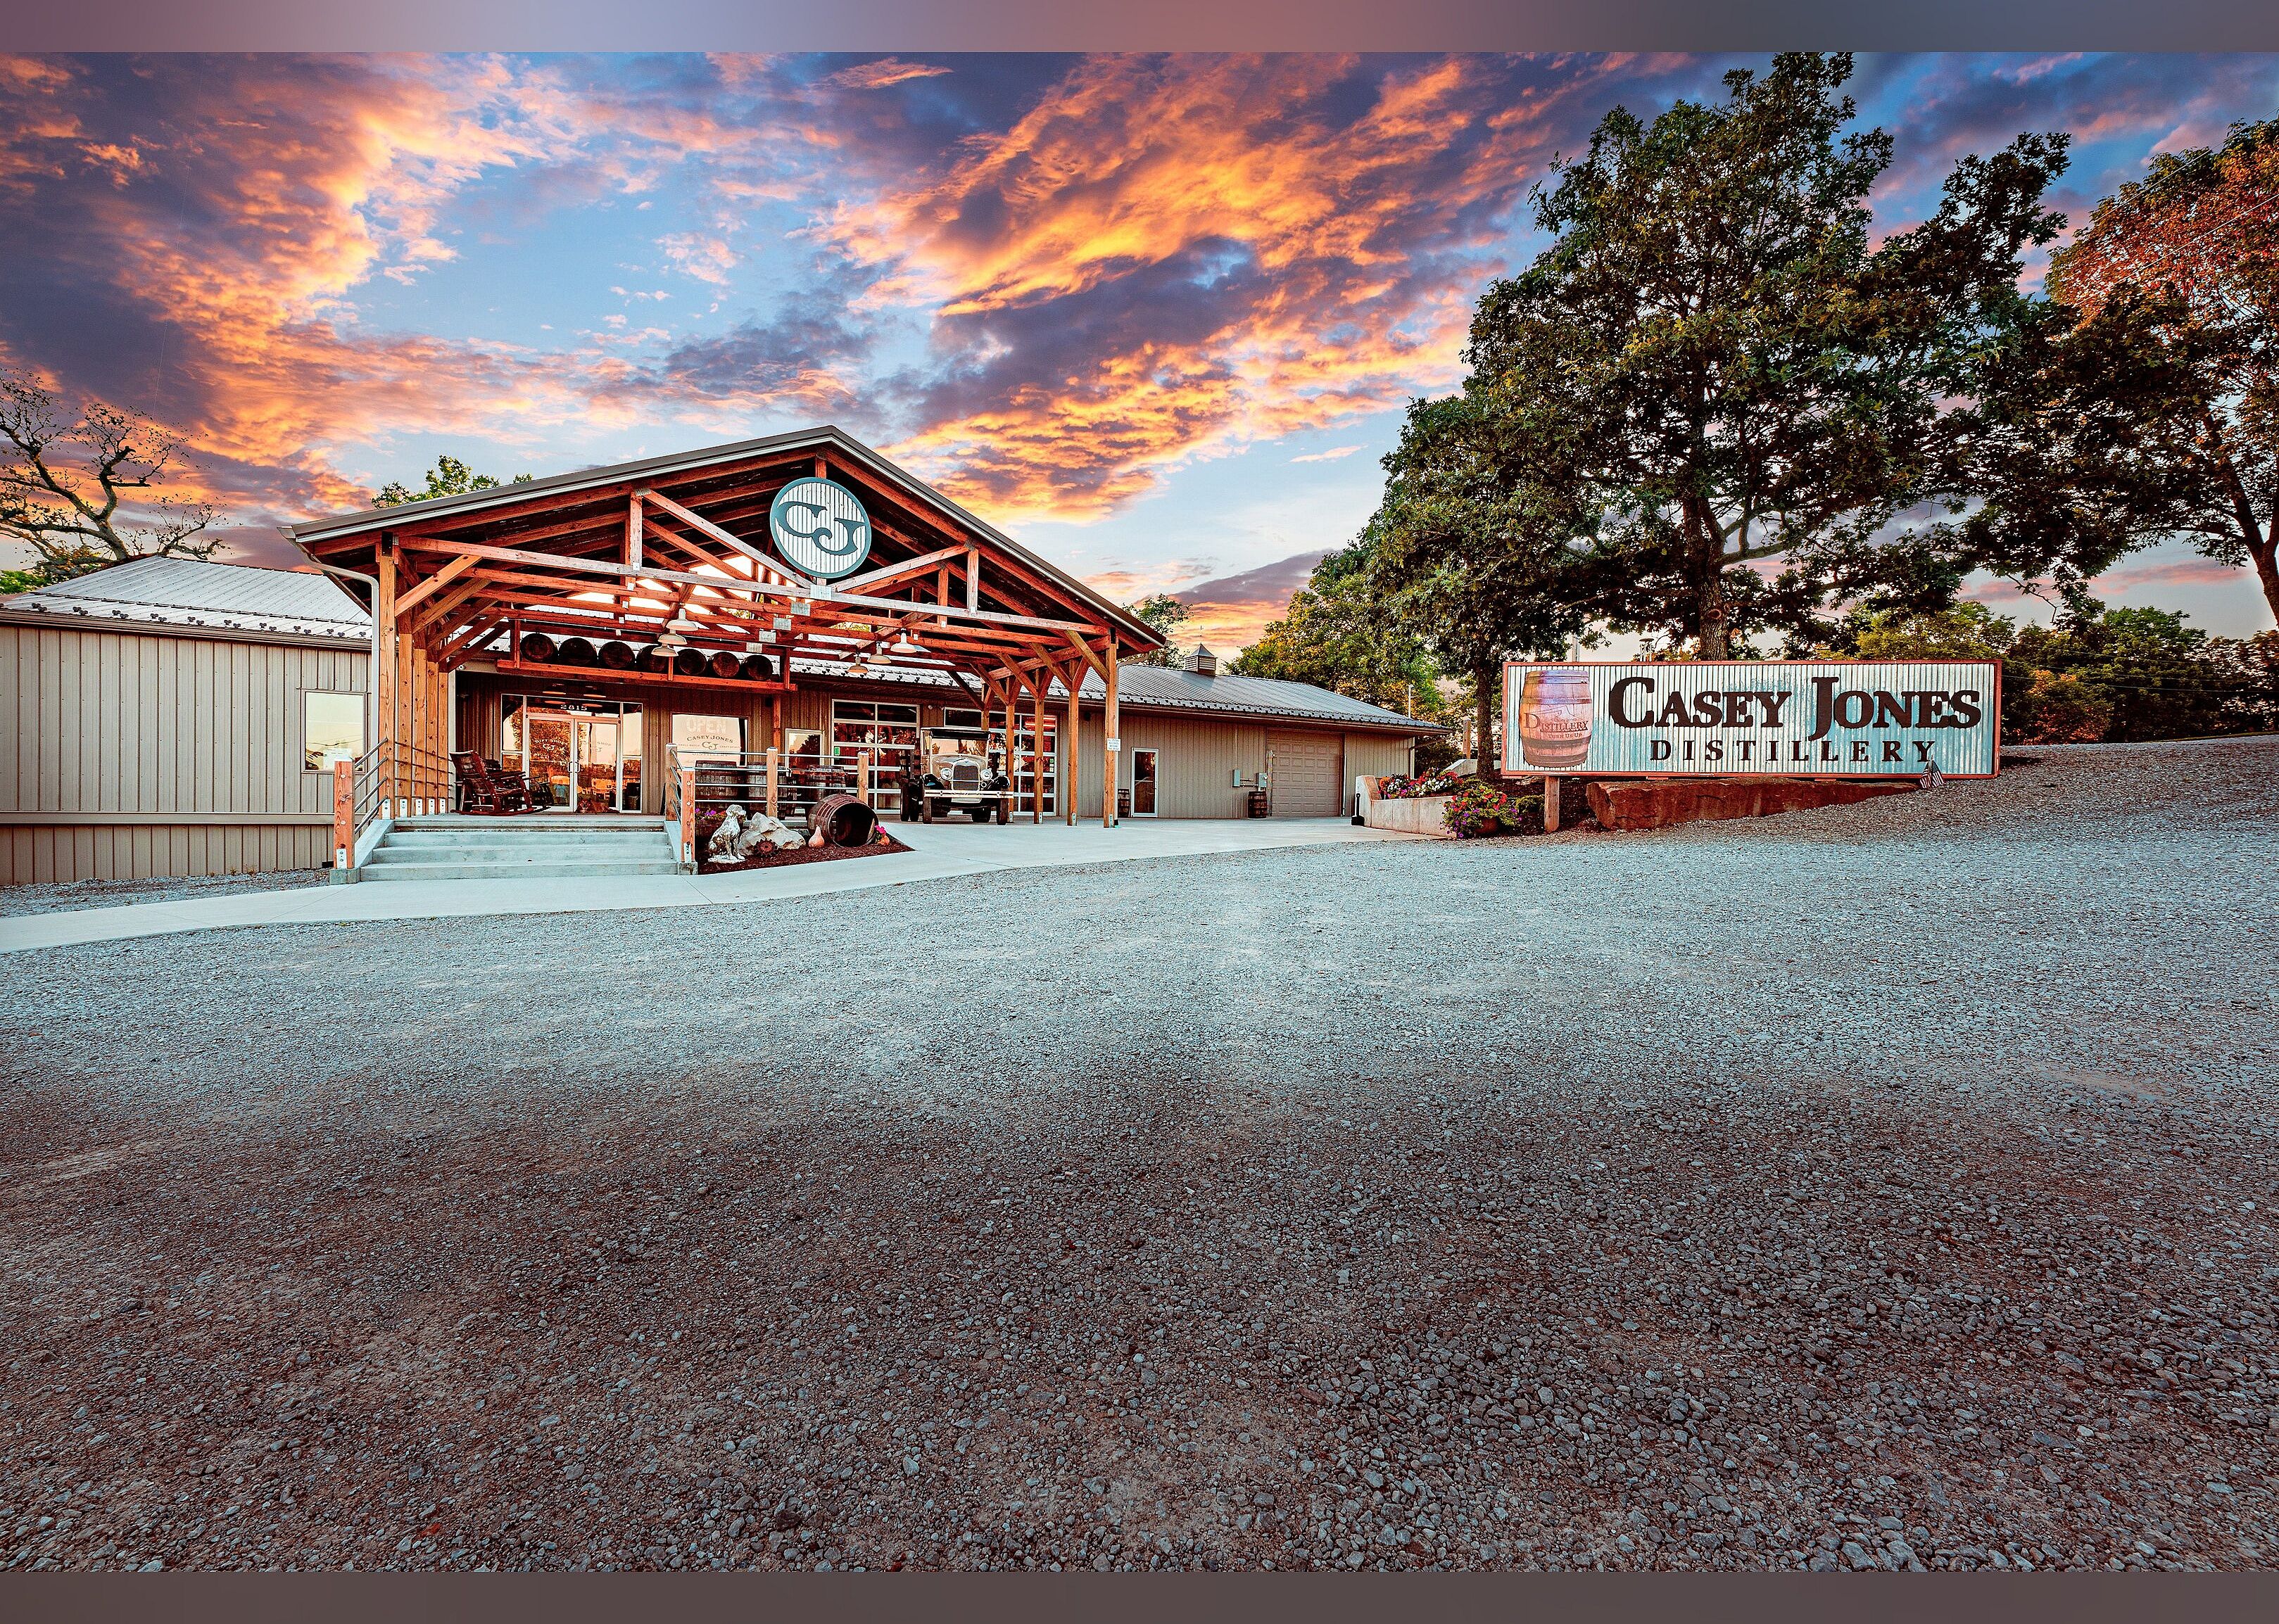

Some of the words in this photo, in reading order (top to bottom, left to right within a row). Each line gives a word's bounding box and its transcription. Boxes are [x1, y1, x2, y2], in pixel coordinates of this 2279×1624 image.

[775, 501, 866, 556] CJ
[1608, 676, 1793, 728] CASEY
[1807, 676, 1982, 741] JONES
[686, 717, 726, 732] OPEN
[1523, 712, 1589, 731] DISTILLERY
[1649, 740, 1936, 763] DISTILLERY
